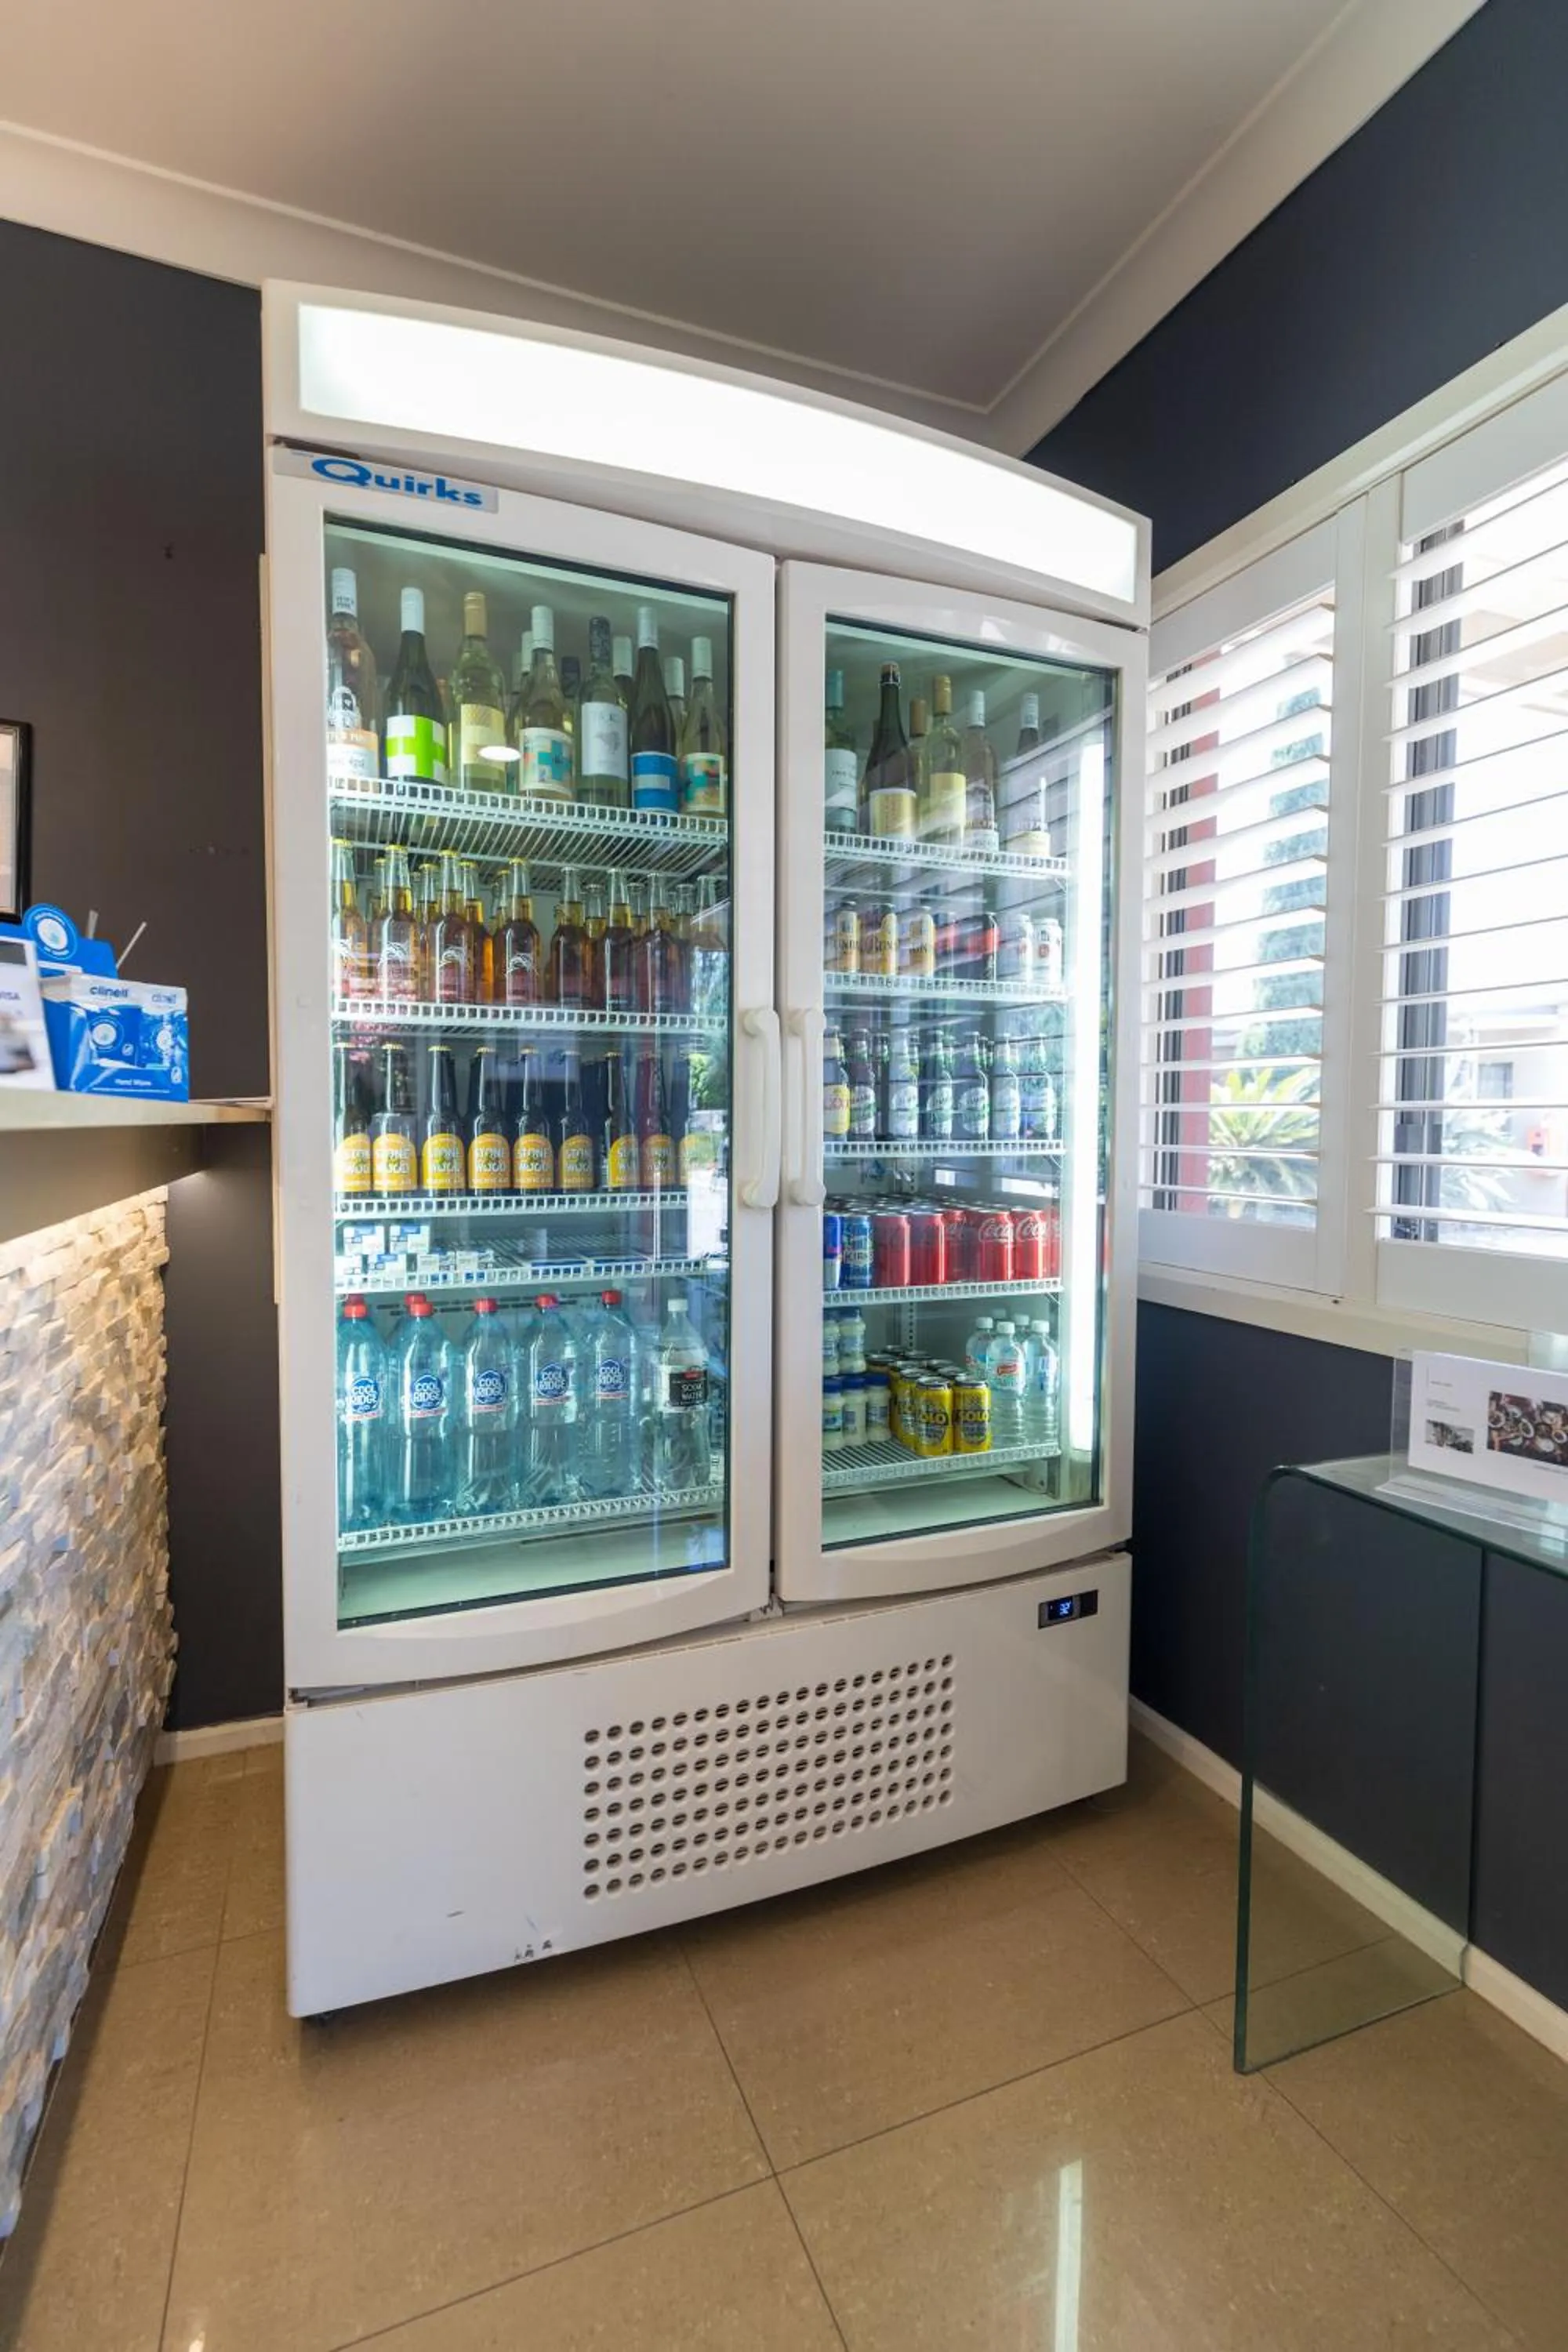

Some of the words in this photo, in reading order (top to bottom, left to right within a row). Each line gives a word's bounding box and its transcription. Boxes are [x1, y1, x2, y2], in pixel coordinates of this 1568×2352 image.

[311, 458, 484, 506] Quirks
[414, 1381, 440, 1393] COOL
[479, 1377, 503, 1388] COOL
[351, 1385, 377, 1396] COOL
[412, 1391, 441, 1403] RIDGE
